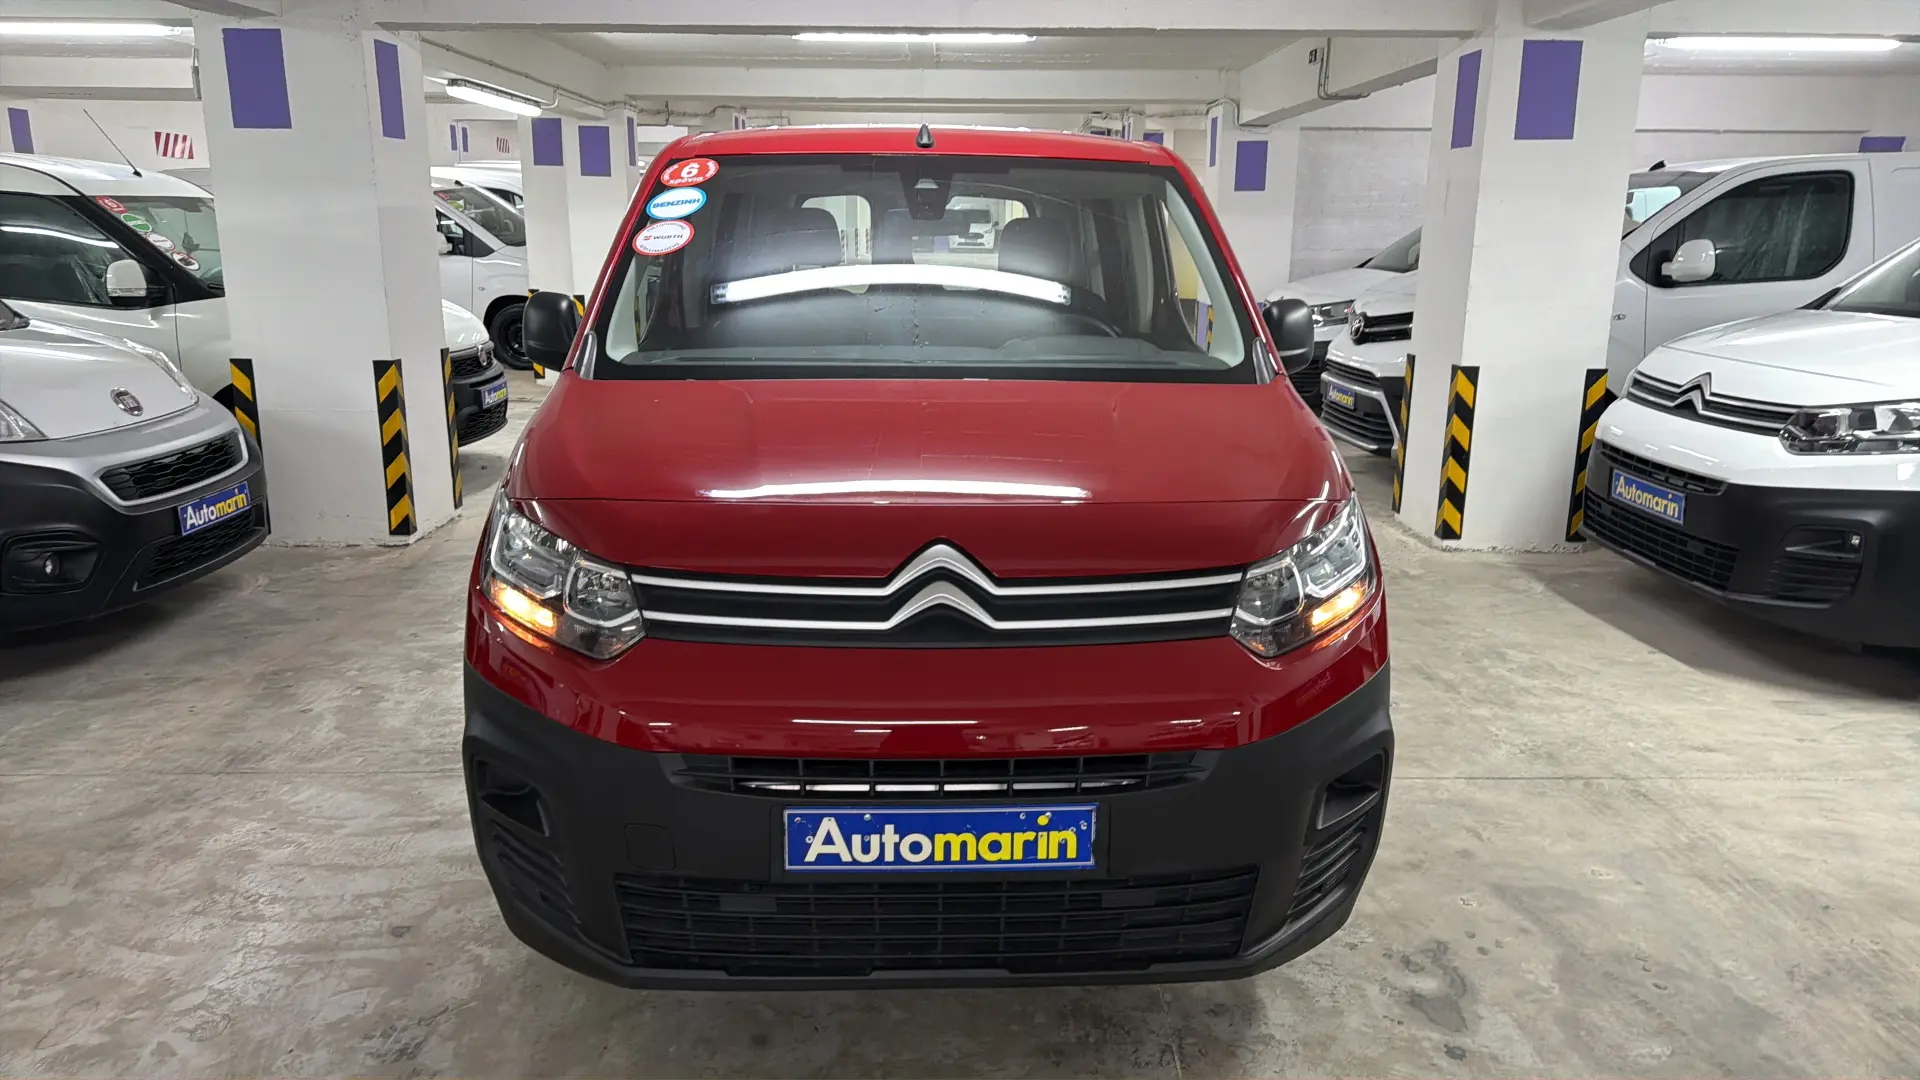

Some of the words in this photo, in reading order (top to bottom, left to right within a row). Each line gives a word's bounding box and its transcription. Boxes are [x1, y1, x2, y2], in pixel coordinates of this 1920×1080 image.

[680, 162, 700, 178] 6
[186, 488, 248, 530] Automarin
[1616, 475, 1679, 519] Automarin
[804, 813, 1078, 864] Automarin
